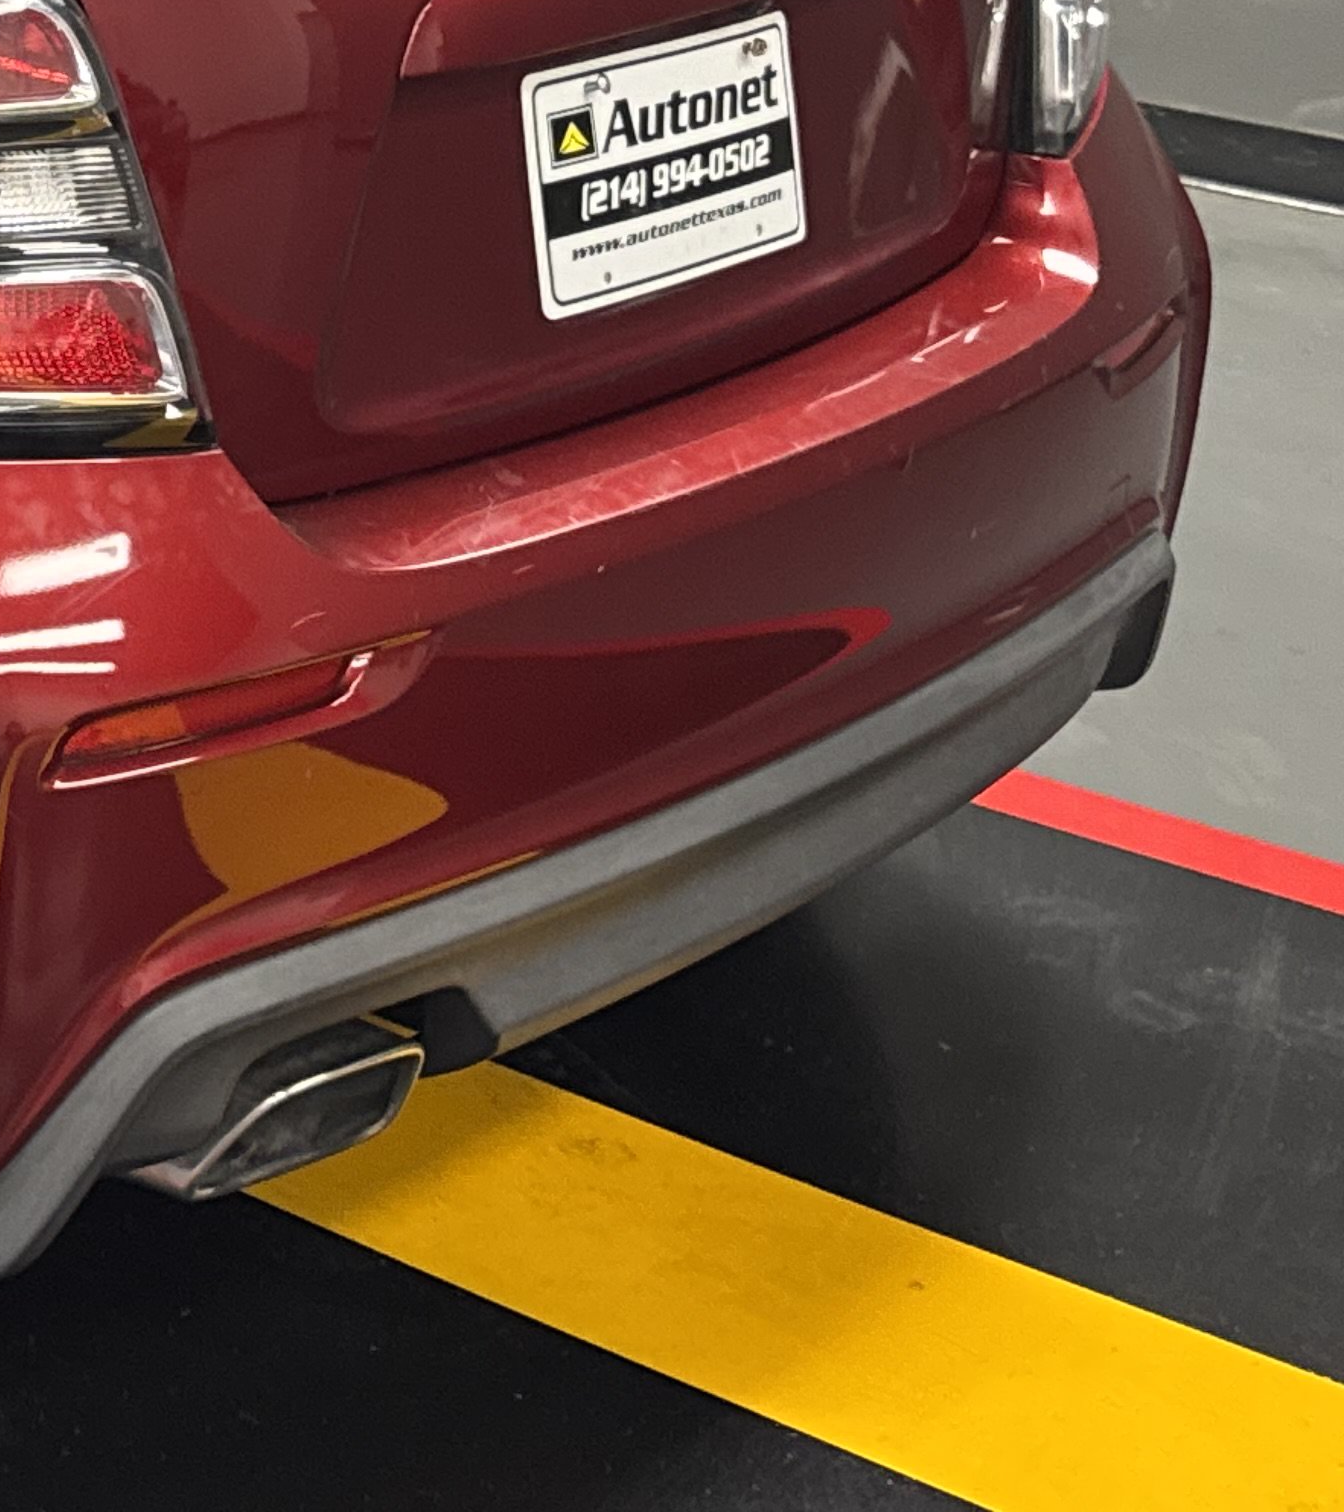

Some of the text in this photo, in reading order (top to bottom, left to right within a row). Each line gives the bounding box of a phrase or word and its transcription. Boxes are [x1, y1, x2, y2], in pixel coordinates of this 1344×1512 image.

[603, 64, 779, 153] Autonet
[580, 133, 772, 223] (214) 994-0502
[572, 189, 782, 261] www.autonettexas.com
